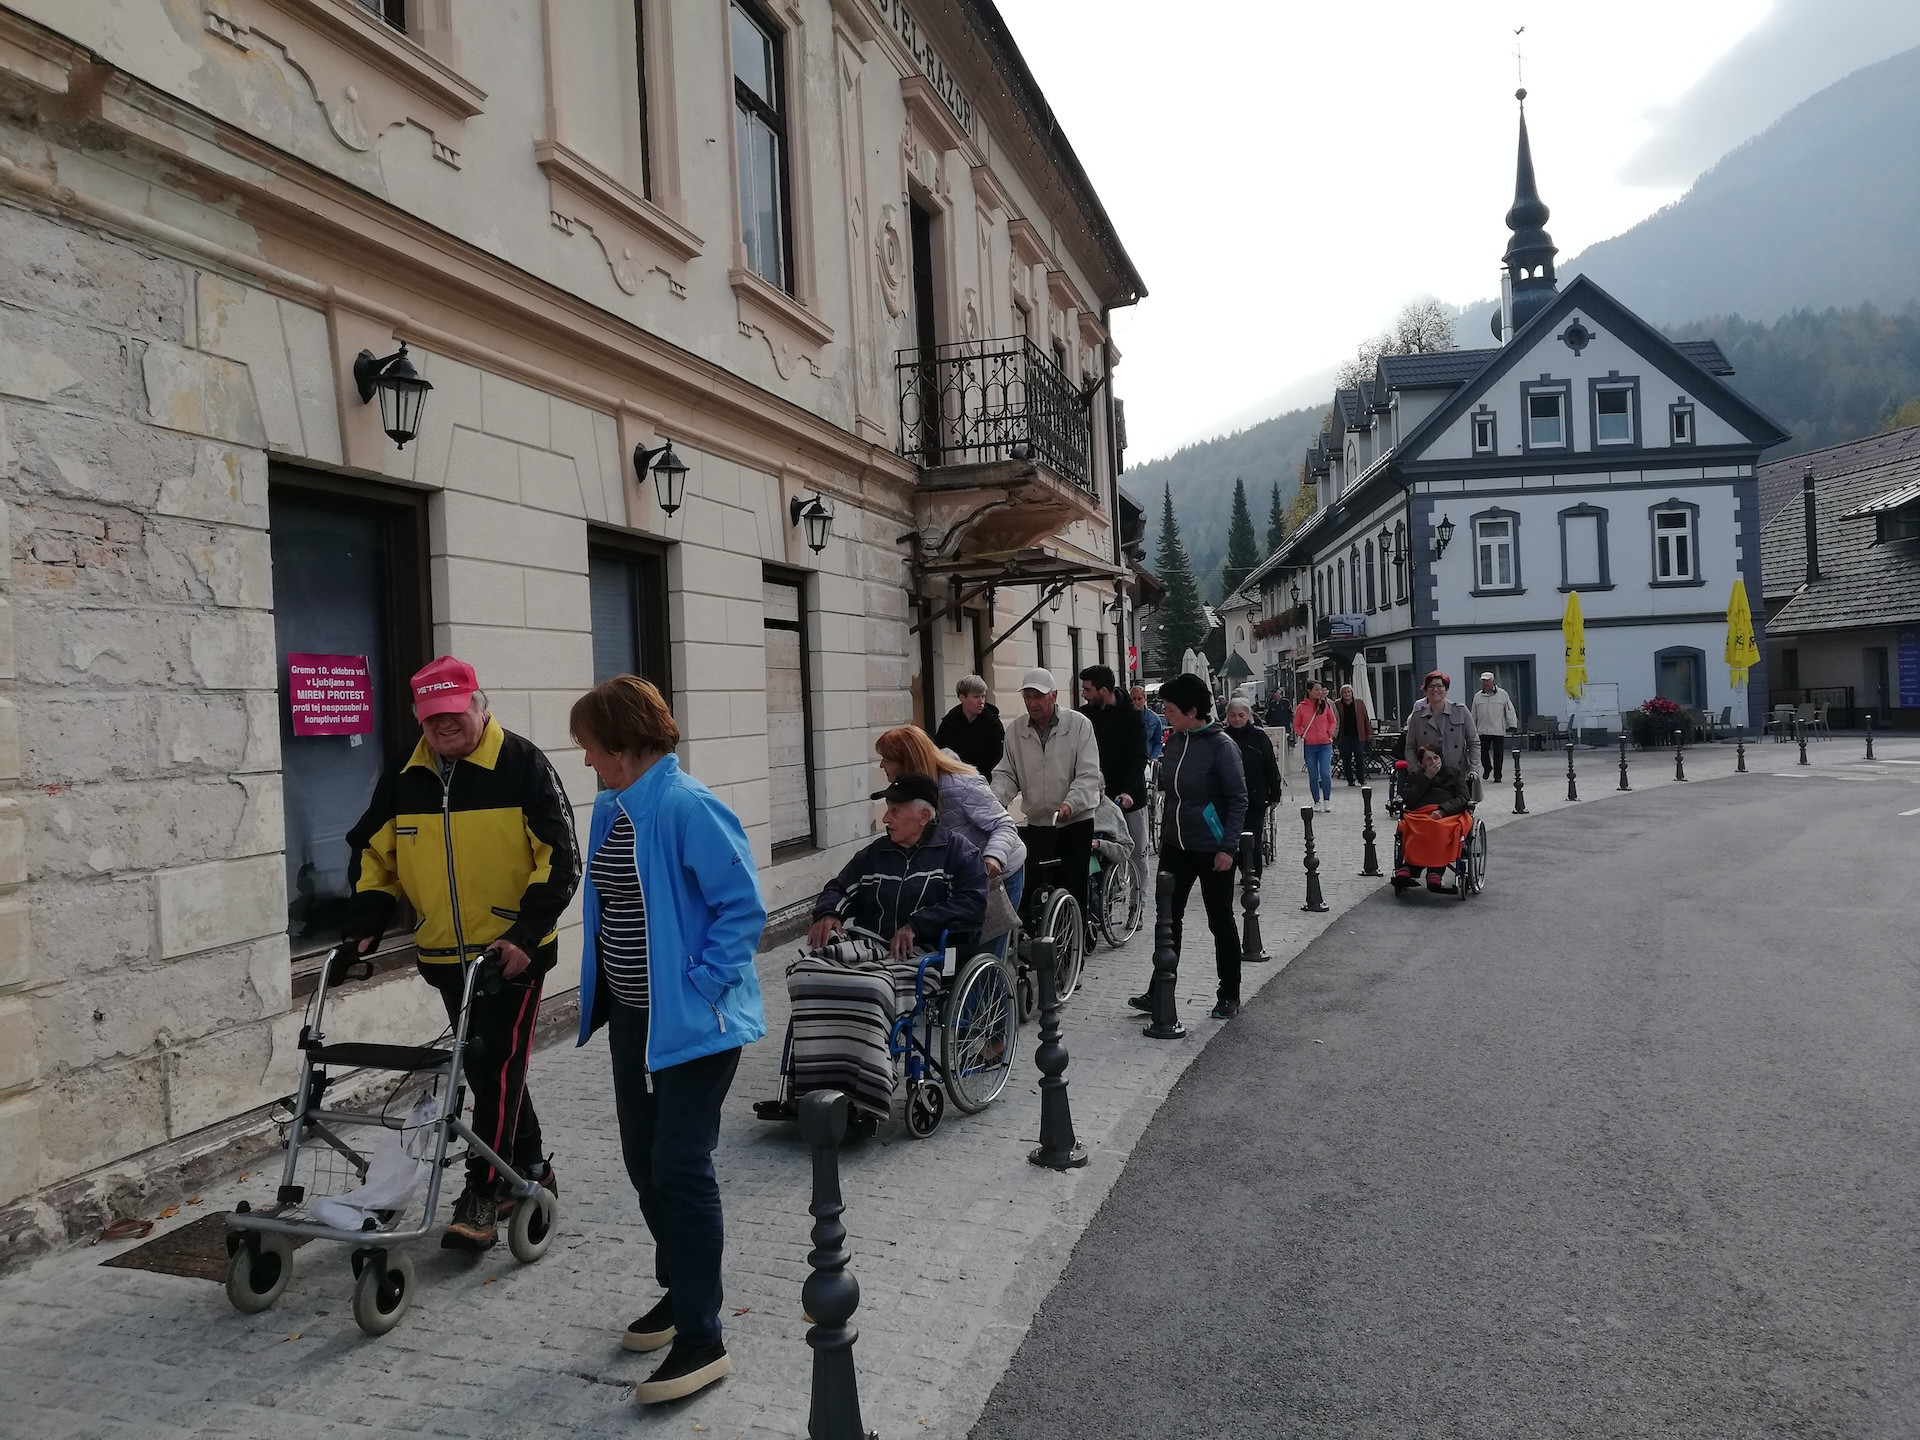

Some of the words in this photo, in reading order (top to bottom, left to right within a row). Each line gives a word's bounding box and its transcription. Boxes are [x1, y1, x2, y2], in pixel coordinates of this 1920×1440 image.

[291, 665, 316, 674] Gremo
[317, 667, 330, 675] 10.
[331, 667, 355, 676] oktobra
[356, 668, 366, 676] vsi
[312, 678, 345, 688] Ljubljano
[416, 681, 459, 694] PETROL
[297, 690, 325, 700] MIREN
[327, 690, 365, 700] PROTEST
[292, 703, 310, 713] proti
[311, 703, 320, 713] tej
[321, 703, 362, 713] nesposobni
[363, 703, 369, 711] in
[304, 715, 340, 725] koruptivni
